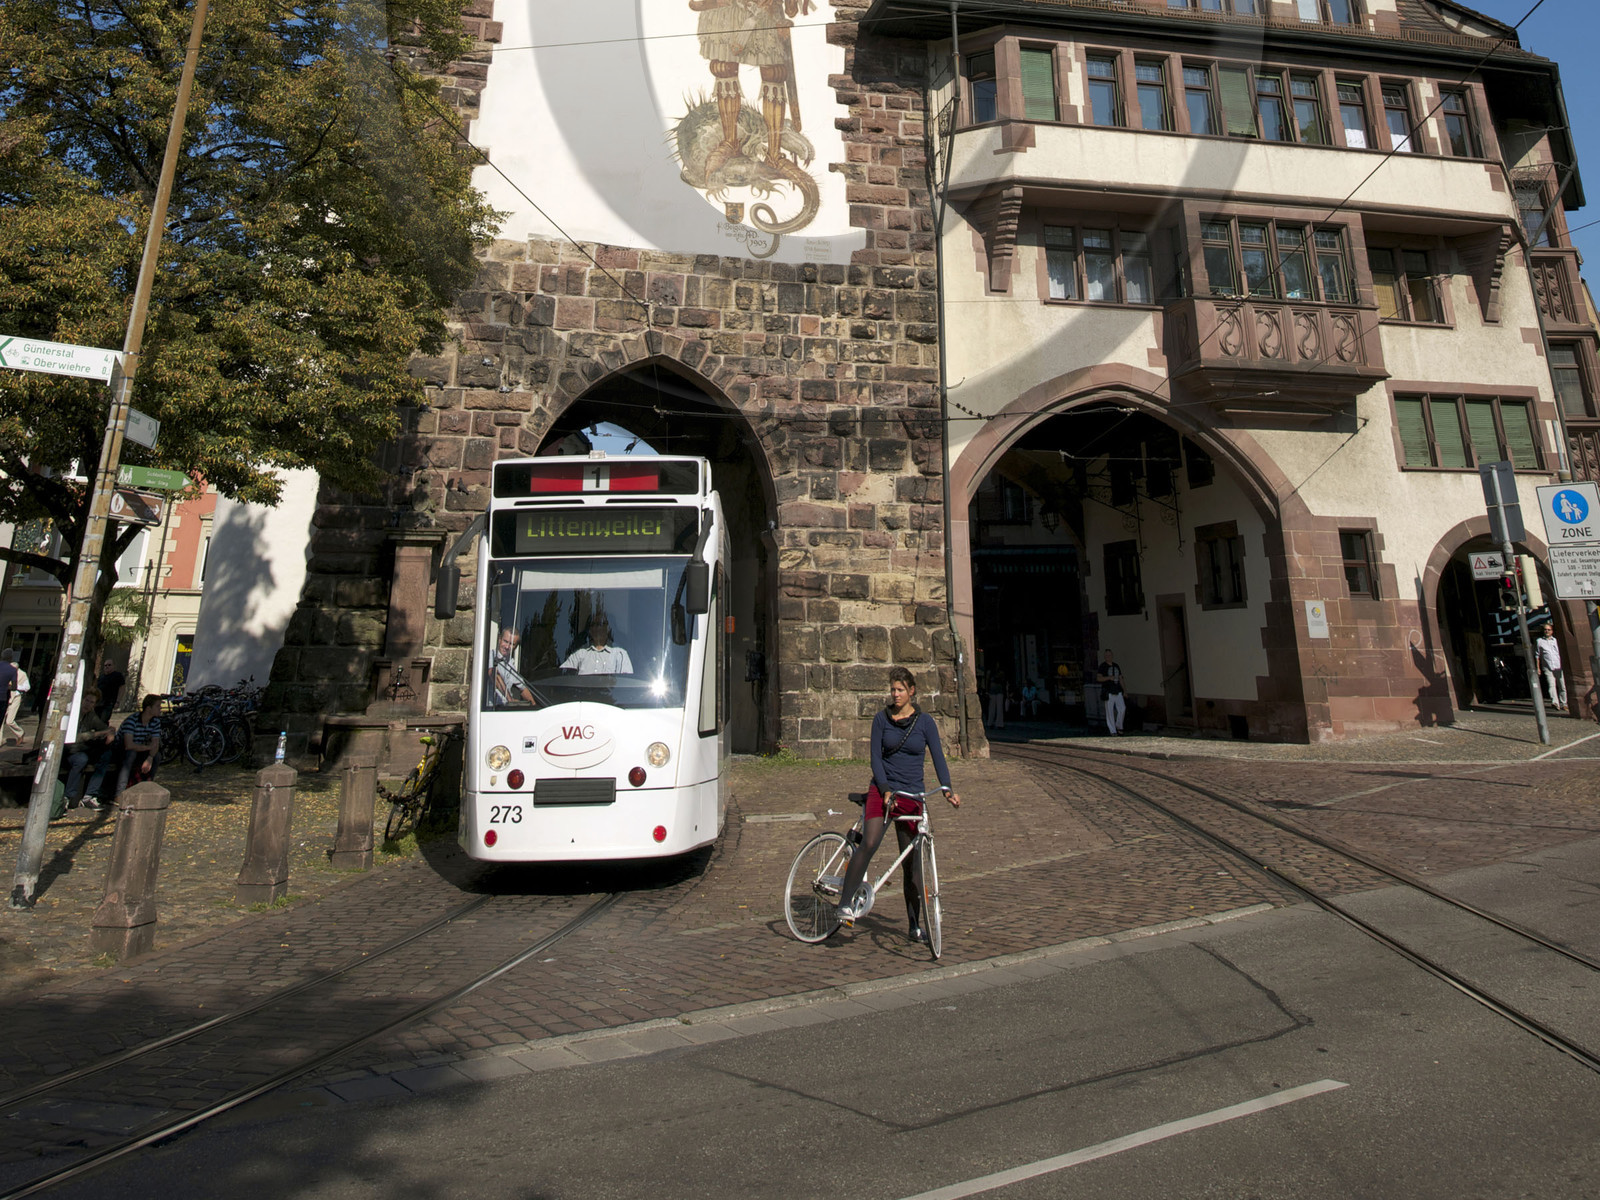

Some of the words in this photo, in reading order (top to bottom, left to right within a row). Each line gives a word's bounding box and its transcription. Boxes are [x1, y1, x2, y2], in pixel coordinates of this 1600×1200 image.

[23, 343, 75, 359] Günterstal
[33, 357, 91, 373] Oberwiehre
[591, 467, 600, 488] 1
[527, 515, 664, 537] Littenweiler
[1561, 527, 1592, 538] ZONE
[1580, 587, 1594, 596] frei
[562, 725, 595, 740] VAG
[490, 805, 522, 824] 273
